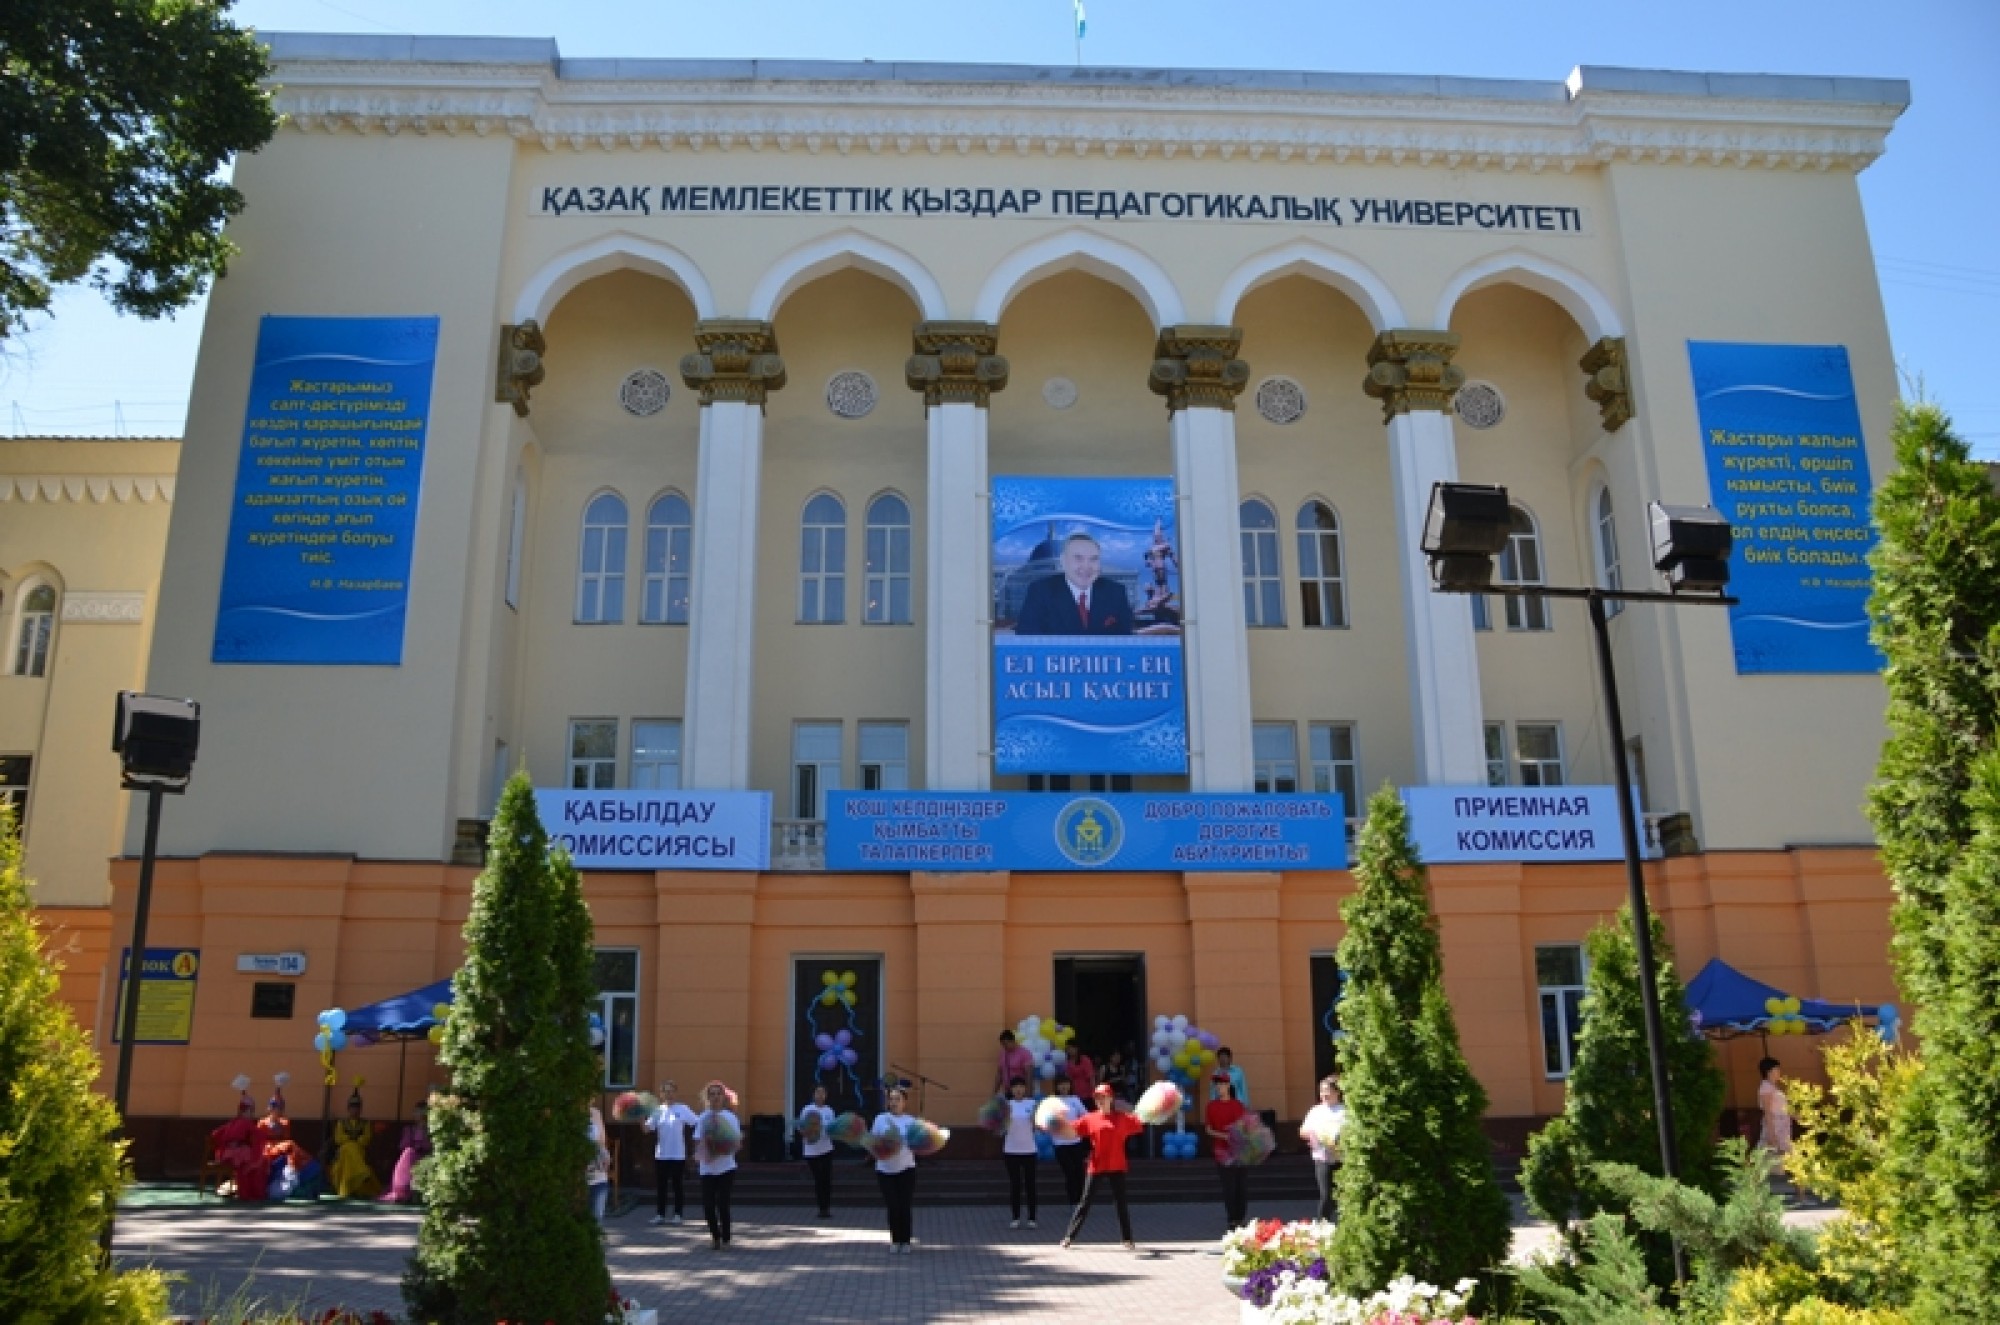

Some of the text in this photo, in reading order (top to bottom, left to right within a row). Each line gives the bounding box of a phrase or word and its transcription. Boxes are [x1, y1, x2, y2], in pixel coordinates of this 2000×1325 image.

[542, 186, 1582, 232] ҚАЗАҚ МЕМЛЕКЕТТІК ҚЫЗДАР ПЕДАГОГИКАЛЫҚ УНИВЕРСИТЕТІ
[1710, 429, 1793, 450] Жастары
[1005, 655, 1033, 673] ЕЛ
[1046, 655, 1121, 673] БІРЛІГІ
[1141, 655, 1173, 675] ЕҢ
[1005, 681, 1173, 702] АСЫЛ ҚАСИЕТ
[564, 799, 716, 827] ҚАБЫЛДАУ
[846, 800, 1006, 820] ҚОШ КЕЛДІҢІЗДЕР
[1145, 801, 1331, 821] ДОБРО ПОЖАЛОВАТЬ
[1454, 796, 1590, 818] ПРИЕМНАЯ
[873, 820, 980, 840] ҚЫМБАТТЫ
[1199, 823, 1281, 841] ДОРОГИЕ
[1457, 829, 1596, 851] КОМИССИЯ
[1172, 844, 1309, 862] АБИТУРИЕНТЫ!
